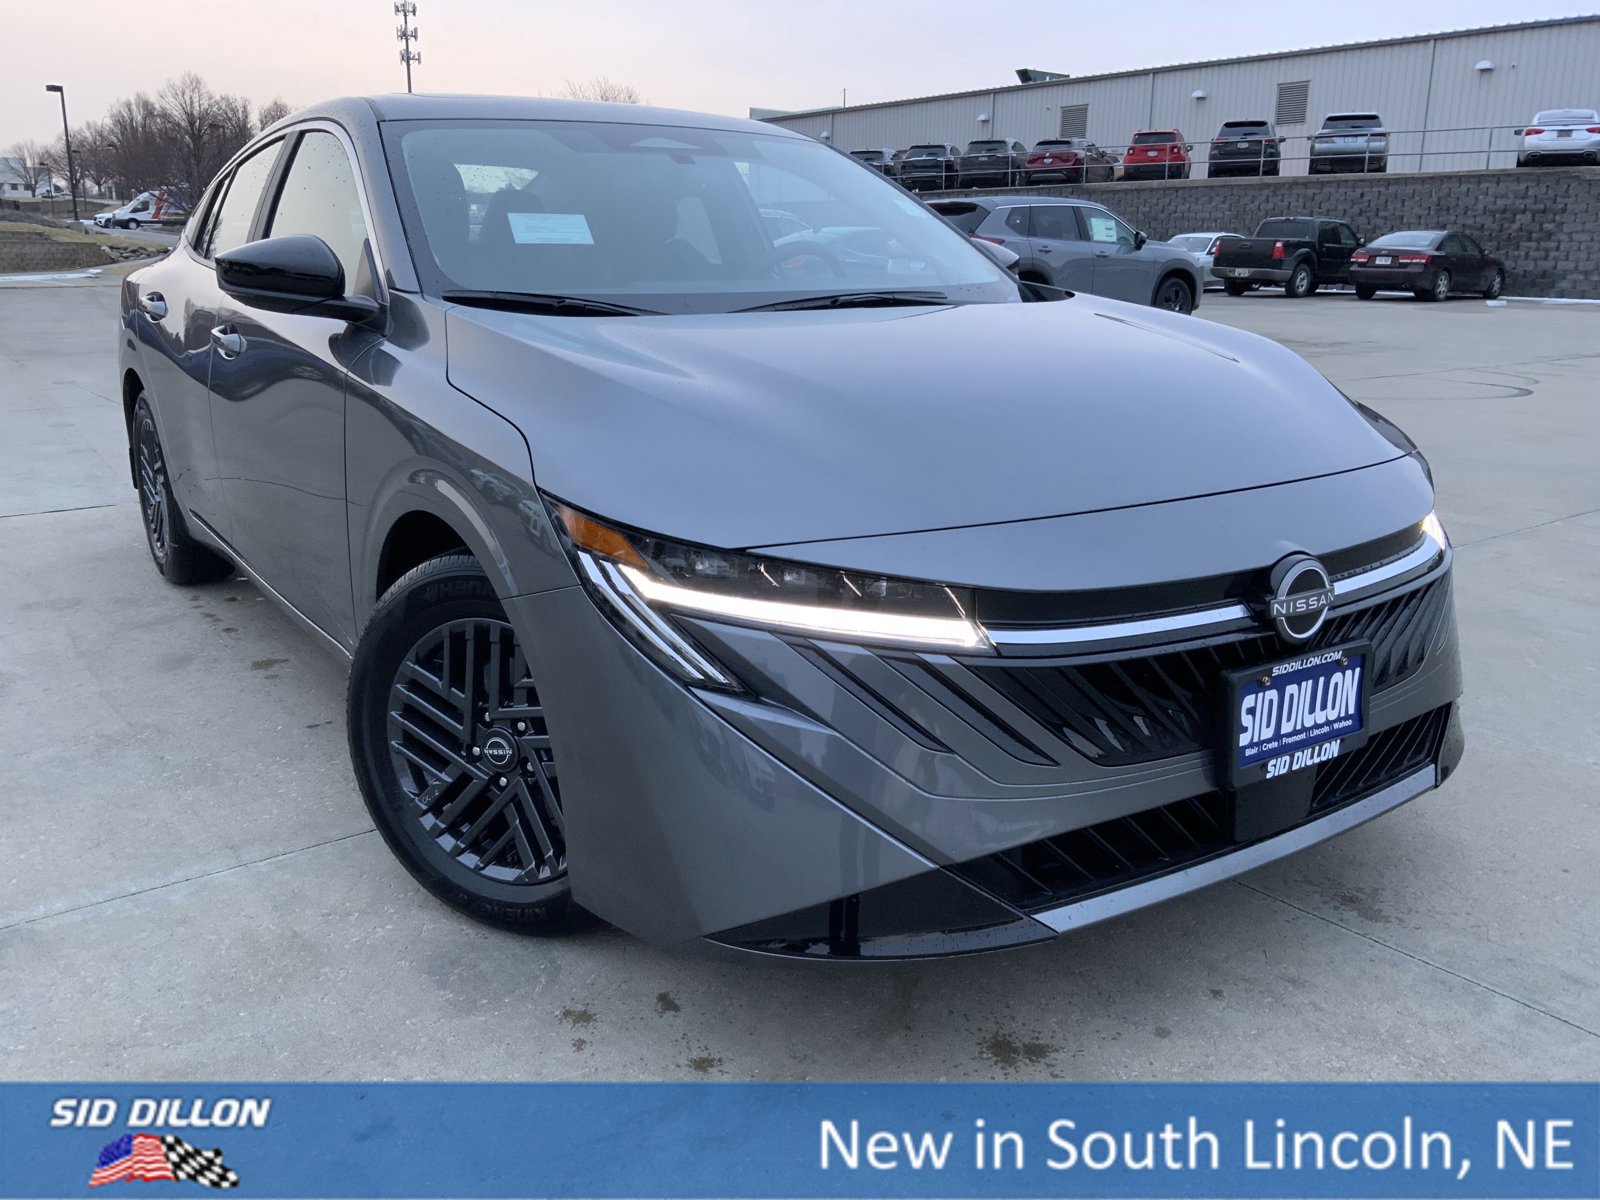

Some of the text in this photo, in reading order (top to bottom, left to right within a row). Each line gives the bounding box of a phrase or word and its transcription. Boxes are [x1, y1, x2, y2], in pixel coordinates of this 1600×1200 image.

[1274, 592, 1334, 615] NISSAN
[1272, 651, 1342, 676] SIDDILLON.COM
[1239, 667, 1361, 746] SID DILLON
[1245, 719, 1352, 757] Blair Crete Fremont Lincoln Wahoo
[1267, 739, 1341, 779] SID DILLON
